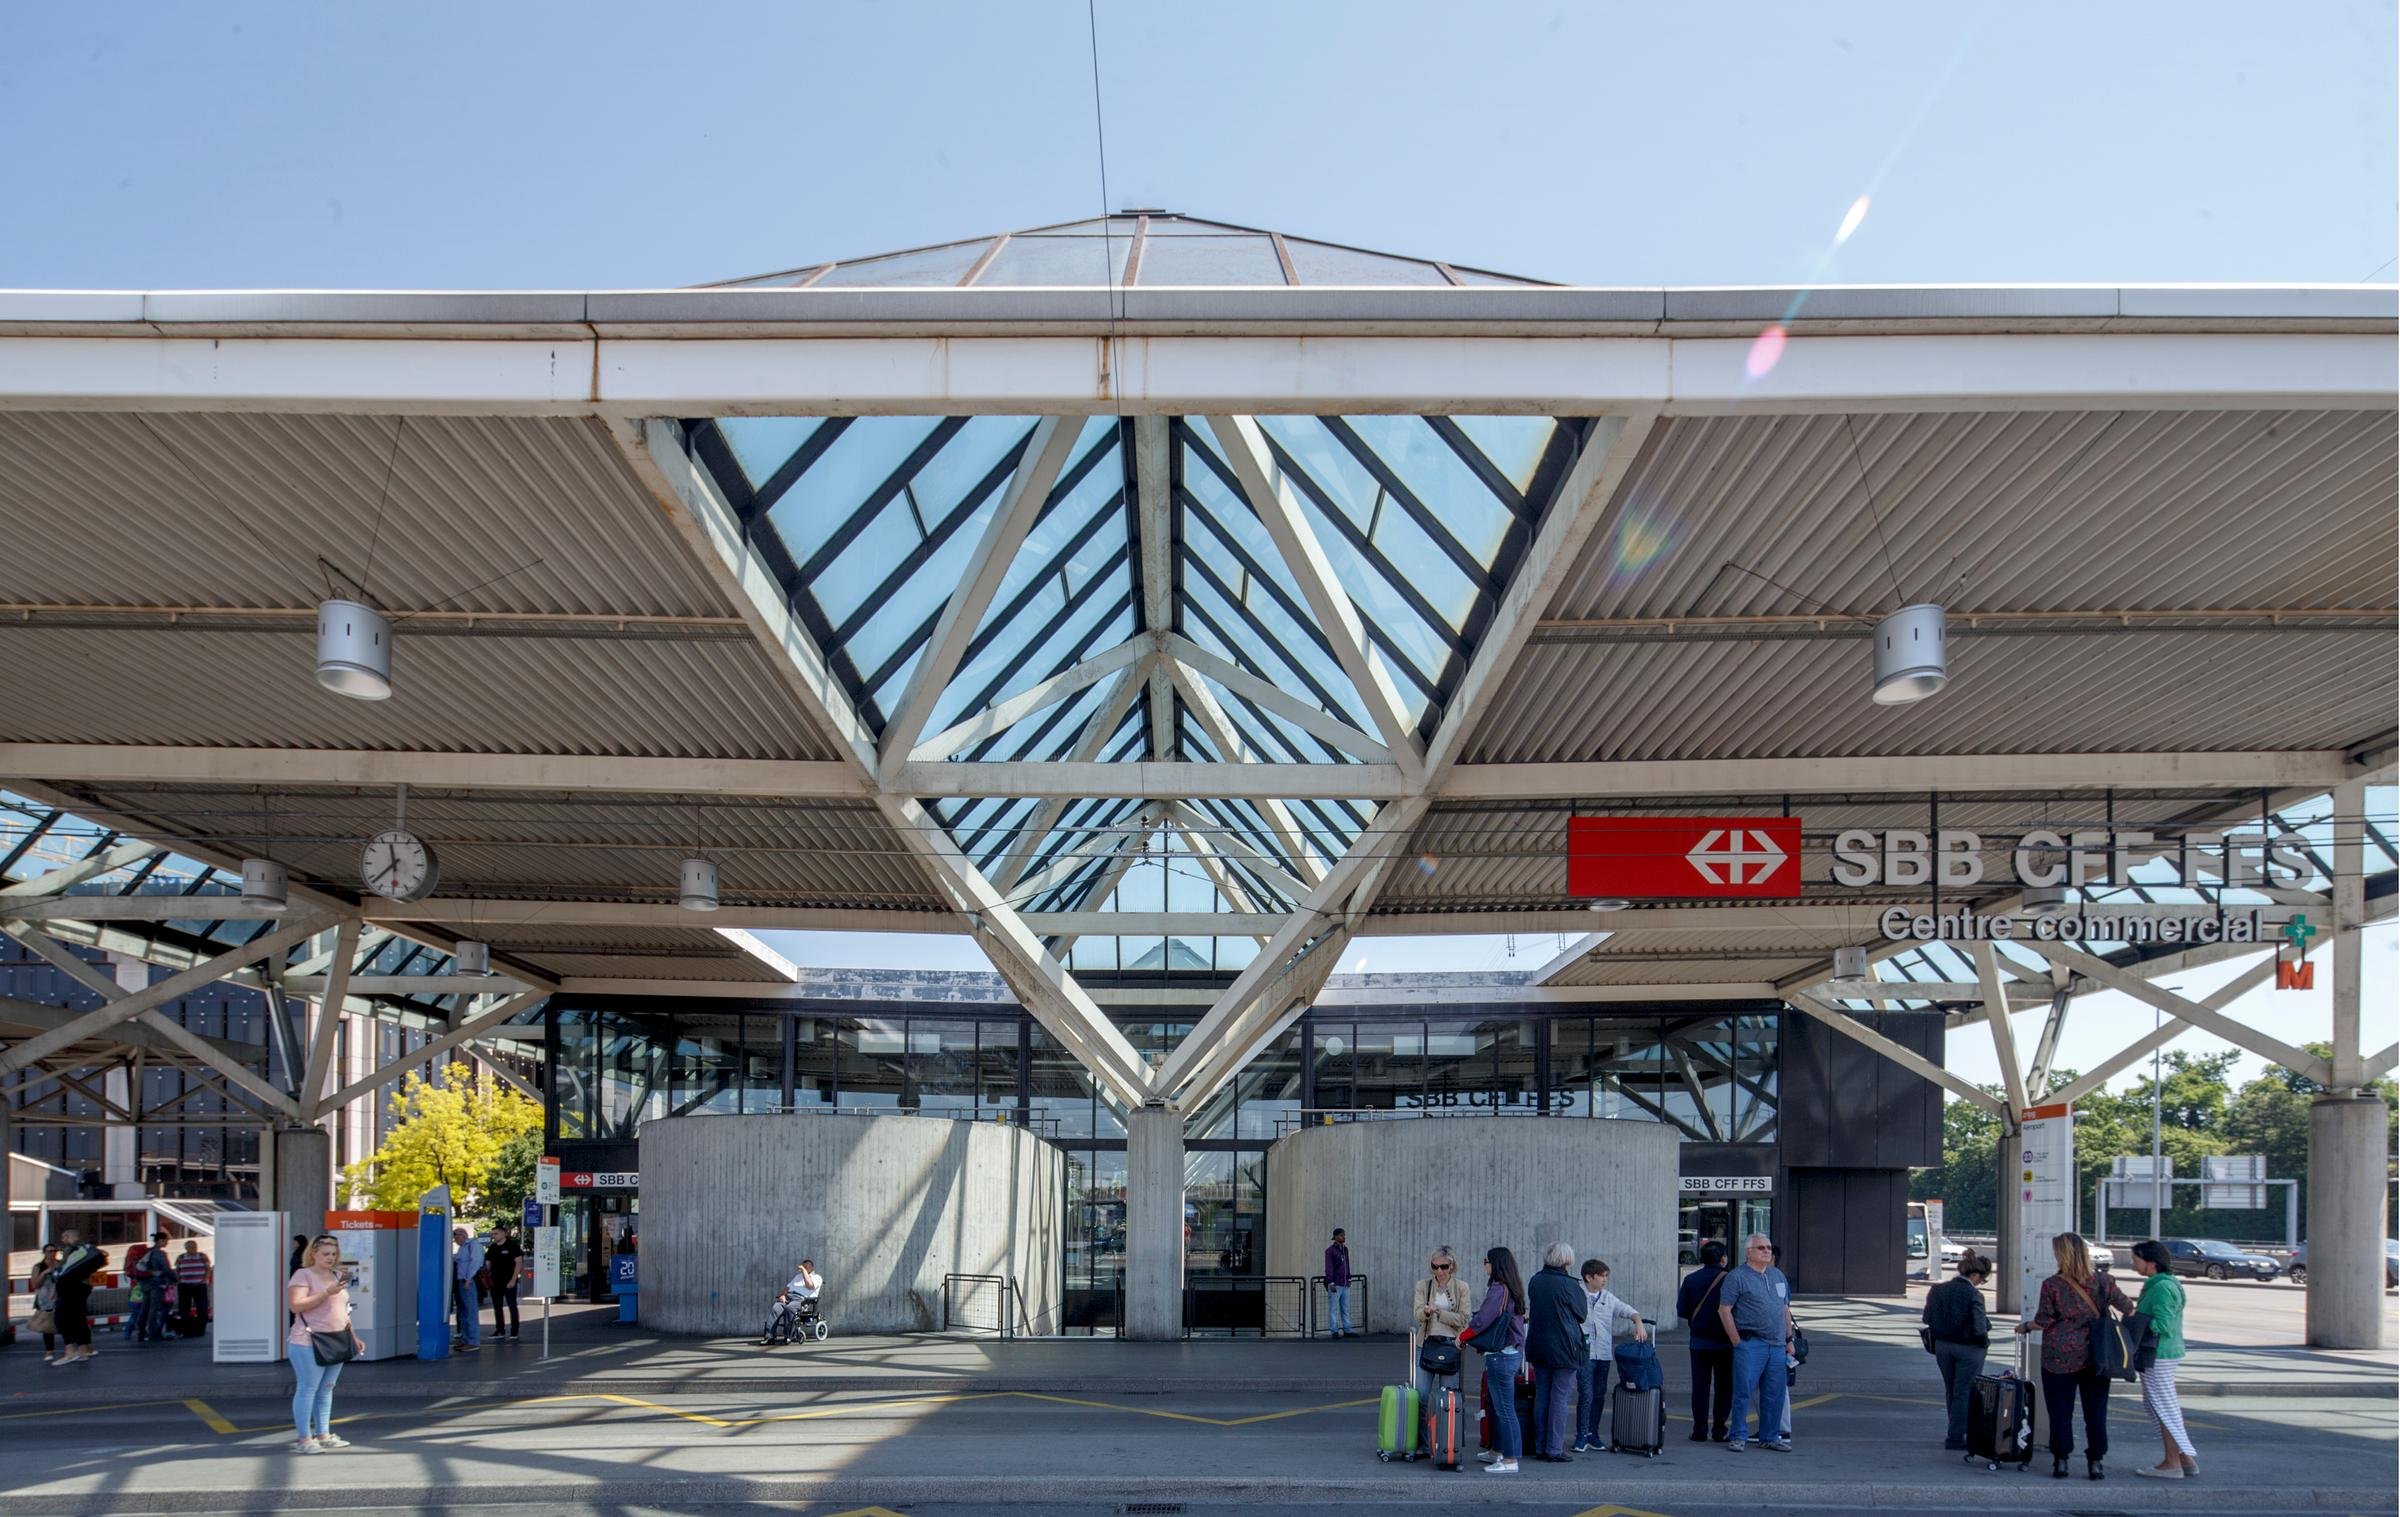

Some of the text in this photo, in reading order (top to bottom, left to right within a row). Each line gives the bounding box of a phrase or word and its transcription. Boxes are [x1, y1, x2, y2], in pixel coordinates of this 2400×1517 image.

[1831, 829, 2313, 890] SBB CFF FFS
[1879, 906, 2263, 942] Centre commercial
[2276, 961, 2314, 990] M
[1406, 1089, 1458, 1108] SBB
[599, 1175, 625, 1185] SBB
[1684, 1179, 1766, 1189] SBB CFF FFS
[340, 1220, 374, 1229] Tickets
[620, 1261, 635, 1275] 20
